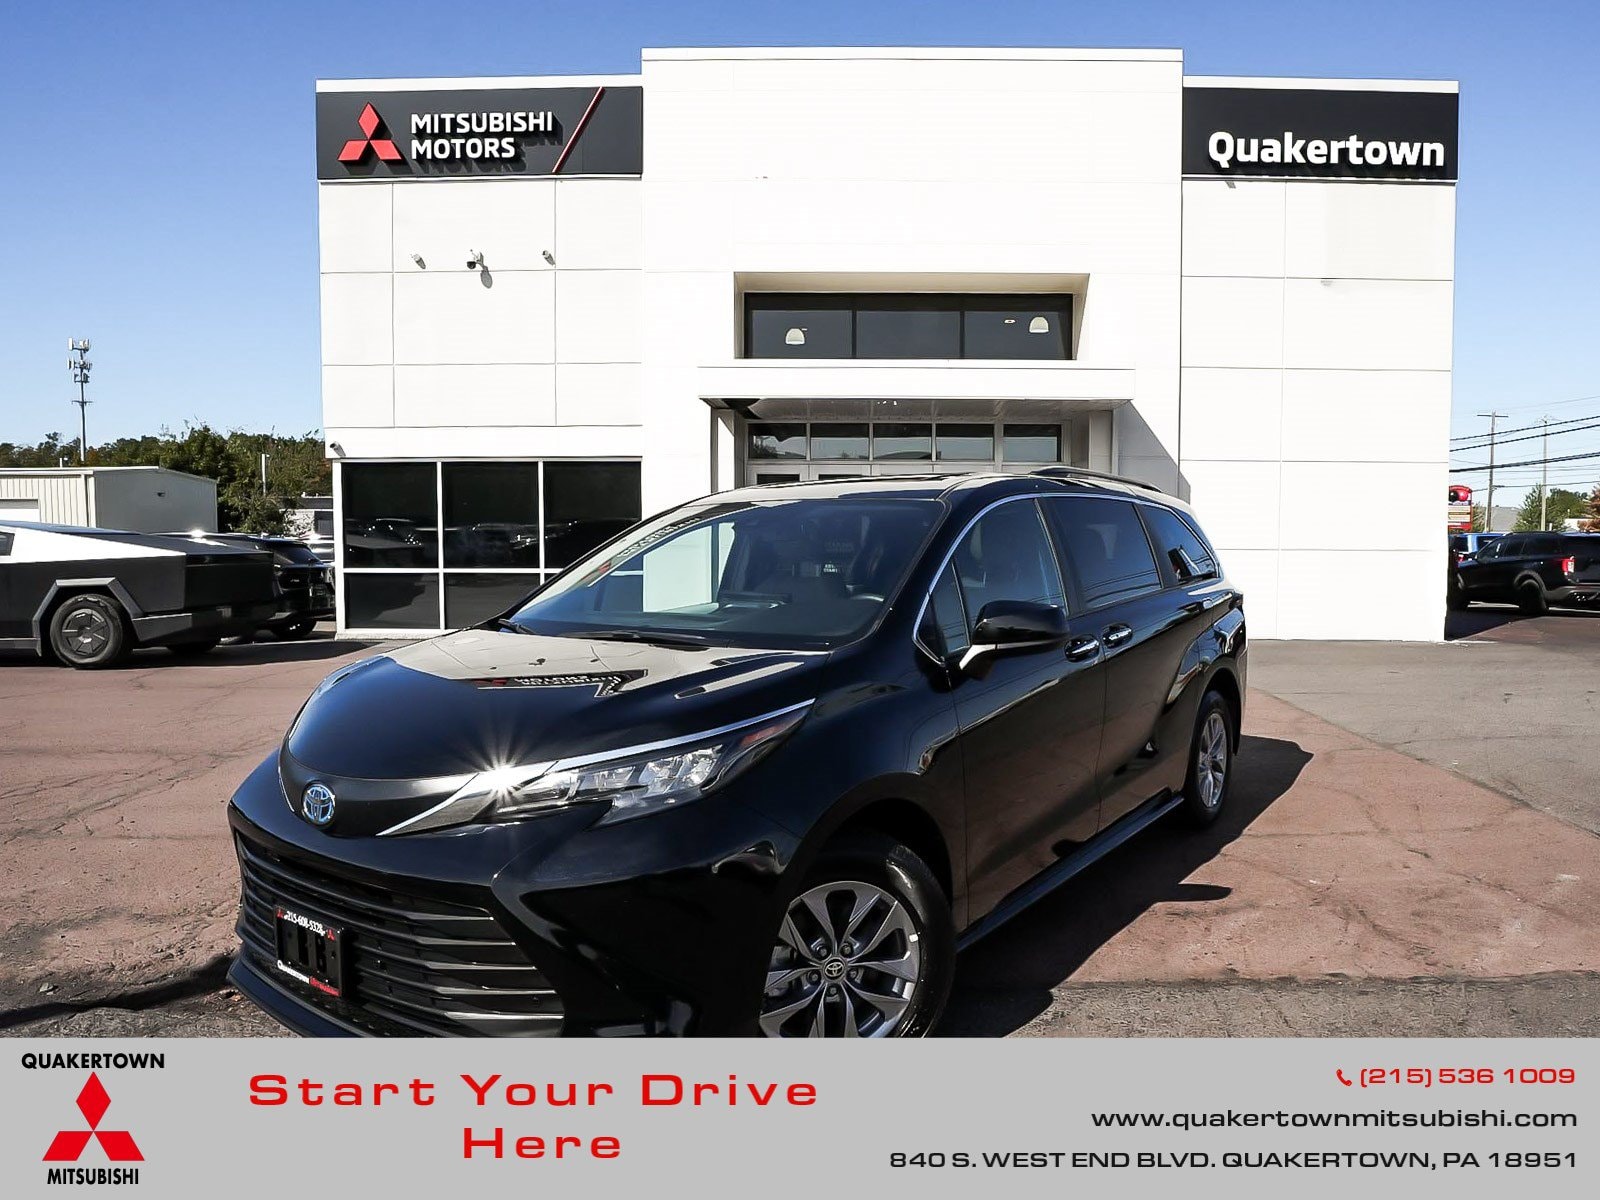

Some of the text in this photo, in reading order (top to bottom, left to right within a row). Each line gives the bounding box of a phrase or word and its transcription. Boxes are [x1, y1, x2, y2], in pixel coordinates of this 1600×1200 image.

[411, 111, 553, 134] MITSUBISHI
[411, 137, 516, 160] MOTORS
[1208, 131, 1445, 168] Quakertown
